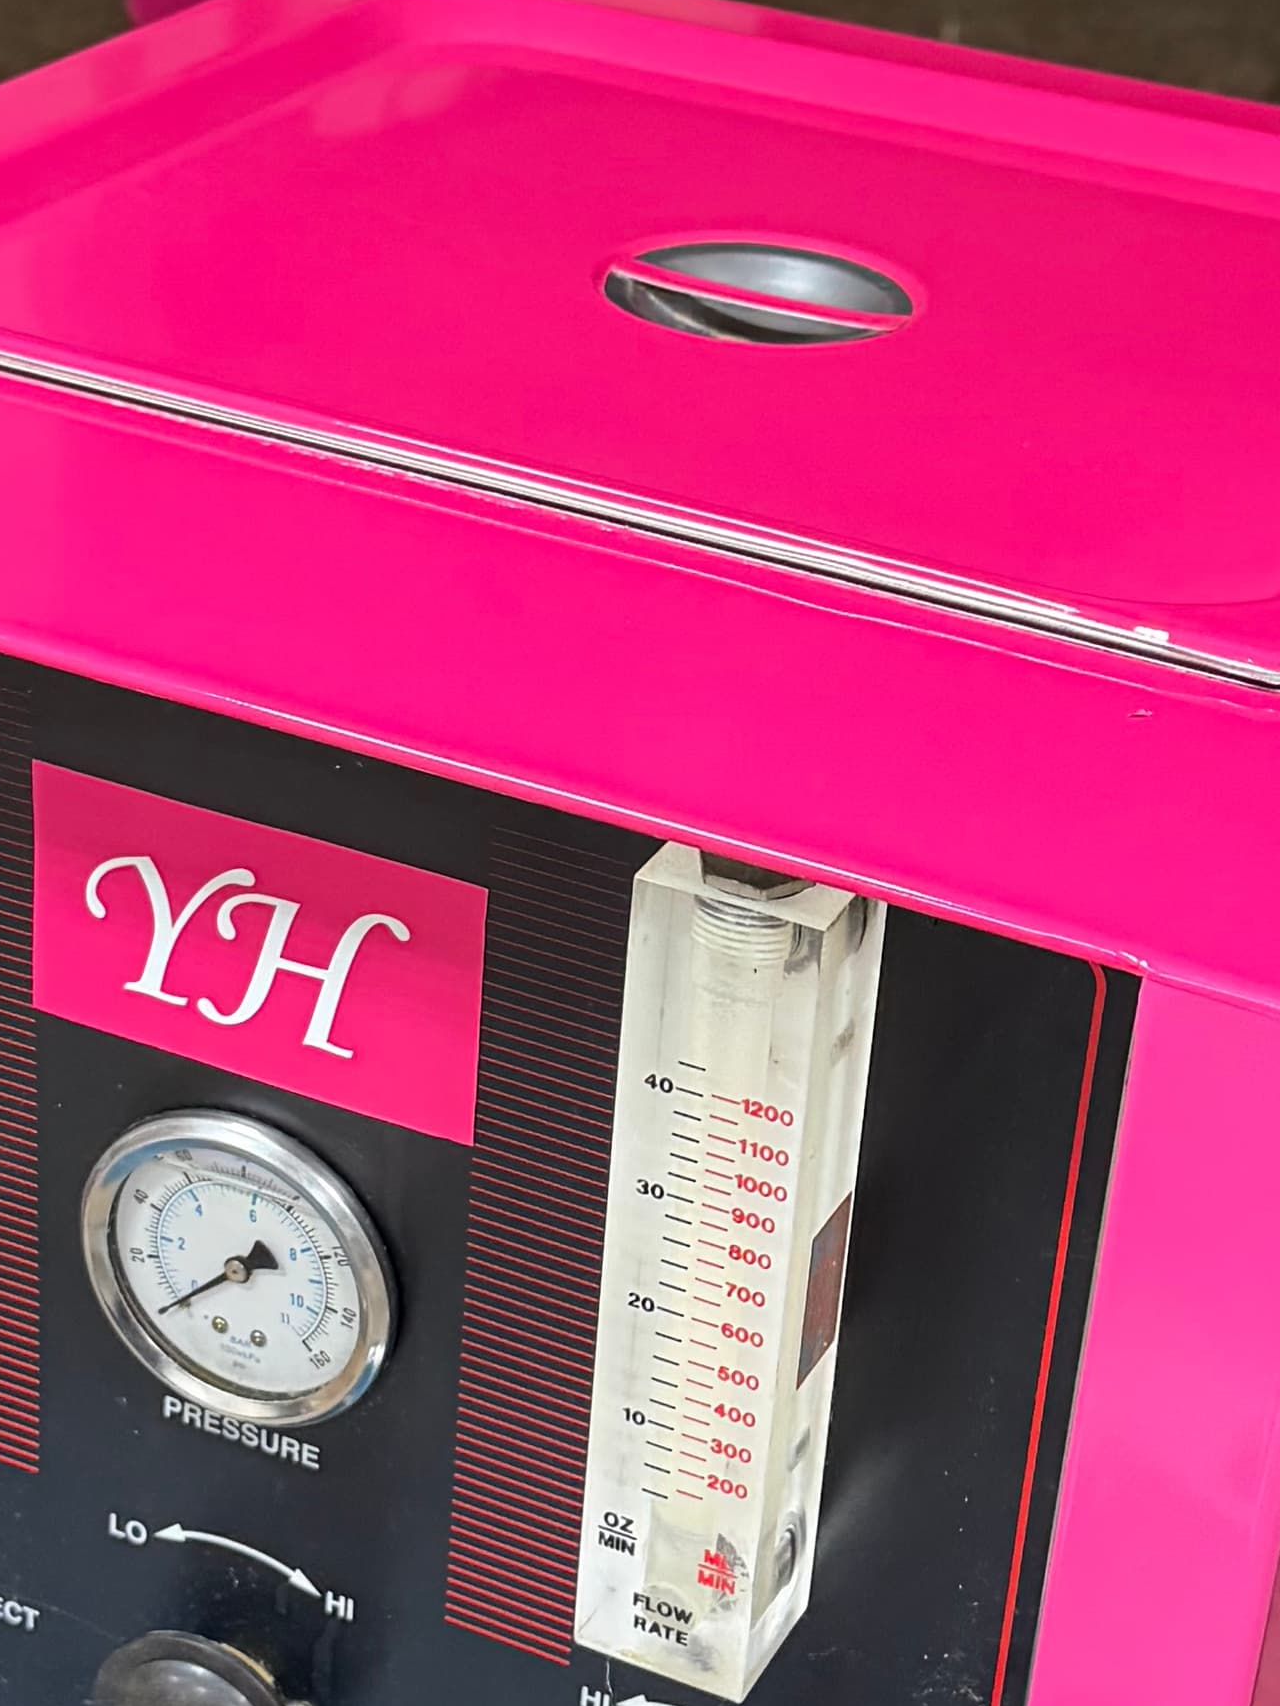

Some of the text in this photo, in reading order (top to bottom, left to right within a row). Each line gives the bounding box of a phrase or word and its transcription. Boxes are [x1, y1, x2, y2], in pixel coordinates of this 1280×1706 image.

[85, 856, 411, 1059] YH
[644, 1073, 674, 1094] 40
[740, 1098, 795, 1127] 1200
[737, 1138, 790, 1167] 1100
[133, 1189, 149, 1204] 40
[636, 1179, 665, 1200] 30
[734, 1174, 788, 1203] 1000
[249, 1209, 258, 1223] 6
[731, 1207, 776, 1234] 900
[130, 1247, 145, 1263] 20
[178, 1237, 186, 1250] 2
[289, 1247, 297, 1261] 8
[728, 1244, 772, 1270] 800
[289, 1293, 304, 1308] 10
[627, 1292, 655, 1313] 20
[725, 1282, 766, 1308] 700
[341, 1307, 358, 1329] 140
[721, 1323, 764, 1348] 600
[309, 1350, 332, 1370] 160
[717, 1365, 760, 1391] 500
[622, 1407, 646, 1426] 10
[713, 1403, 757, 1428] 400
[162, 1395, 321, 1470] PRESSURE
[710, 1438, 753, 1464] 300
[706, 1474, 749, 1499] 200
[108, 1512, 148, 1545] LO
[603, 1511, 635, 1534] OZ
[597, 1531, 636, 1557] MIN
[698, 1569, 736, 1595] MIN
[325, 1590, 355, 1622] HI
[632, 1592, 694, 1626] FLOW
[633, 1614, 689, 1647] RATE
